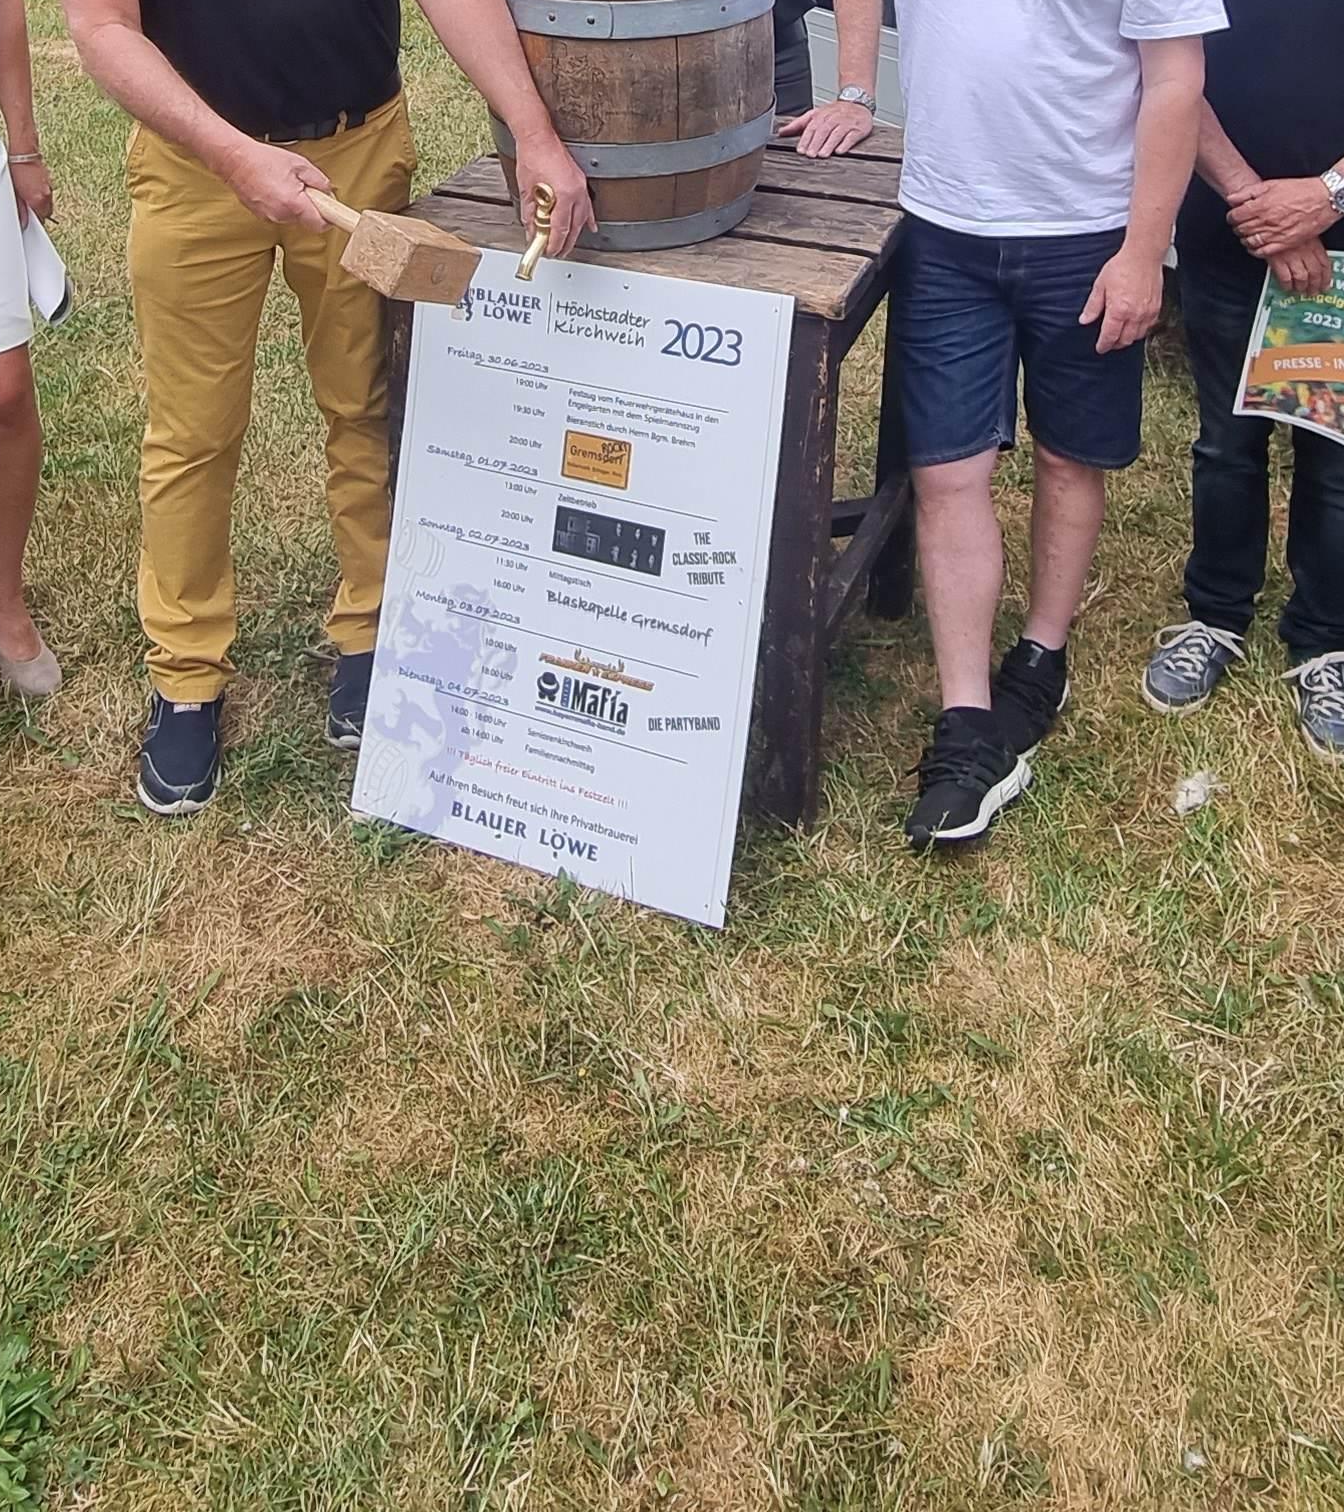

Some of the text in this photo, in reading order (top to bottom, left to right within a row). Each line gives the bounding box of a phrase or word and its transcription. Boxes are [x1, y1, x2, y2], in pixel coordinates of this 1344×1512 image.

[476, 287, 542, 311] BLAUER
[483, 302, 532, 325] LÖWE
[556, 300, 651, 329] Höchstadter
[1302, 312, 1343, 329] 2023
[554, 319, 645, 348] Kirchweih
[660, 319, 743, 366] 2023
[1273, 356, 1322, 372] PRESSE
[693, 532, 711, 545] THE
[672, 552, 737, 566] CLASSIC-ROCK
[687, 572, 725, 585] TRIBUTE
[546, 589, 714, 647] Blaskapelle Gremsdorf
[648, 717, 720, 731] DIE PARTYBAND
[428, 770, 639, 845] Auf Ihren Besuch freut sich Ihre Privatbrauerei
[451, 800, 599, 862] BLAUER LÖWE
